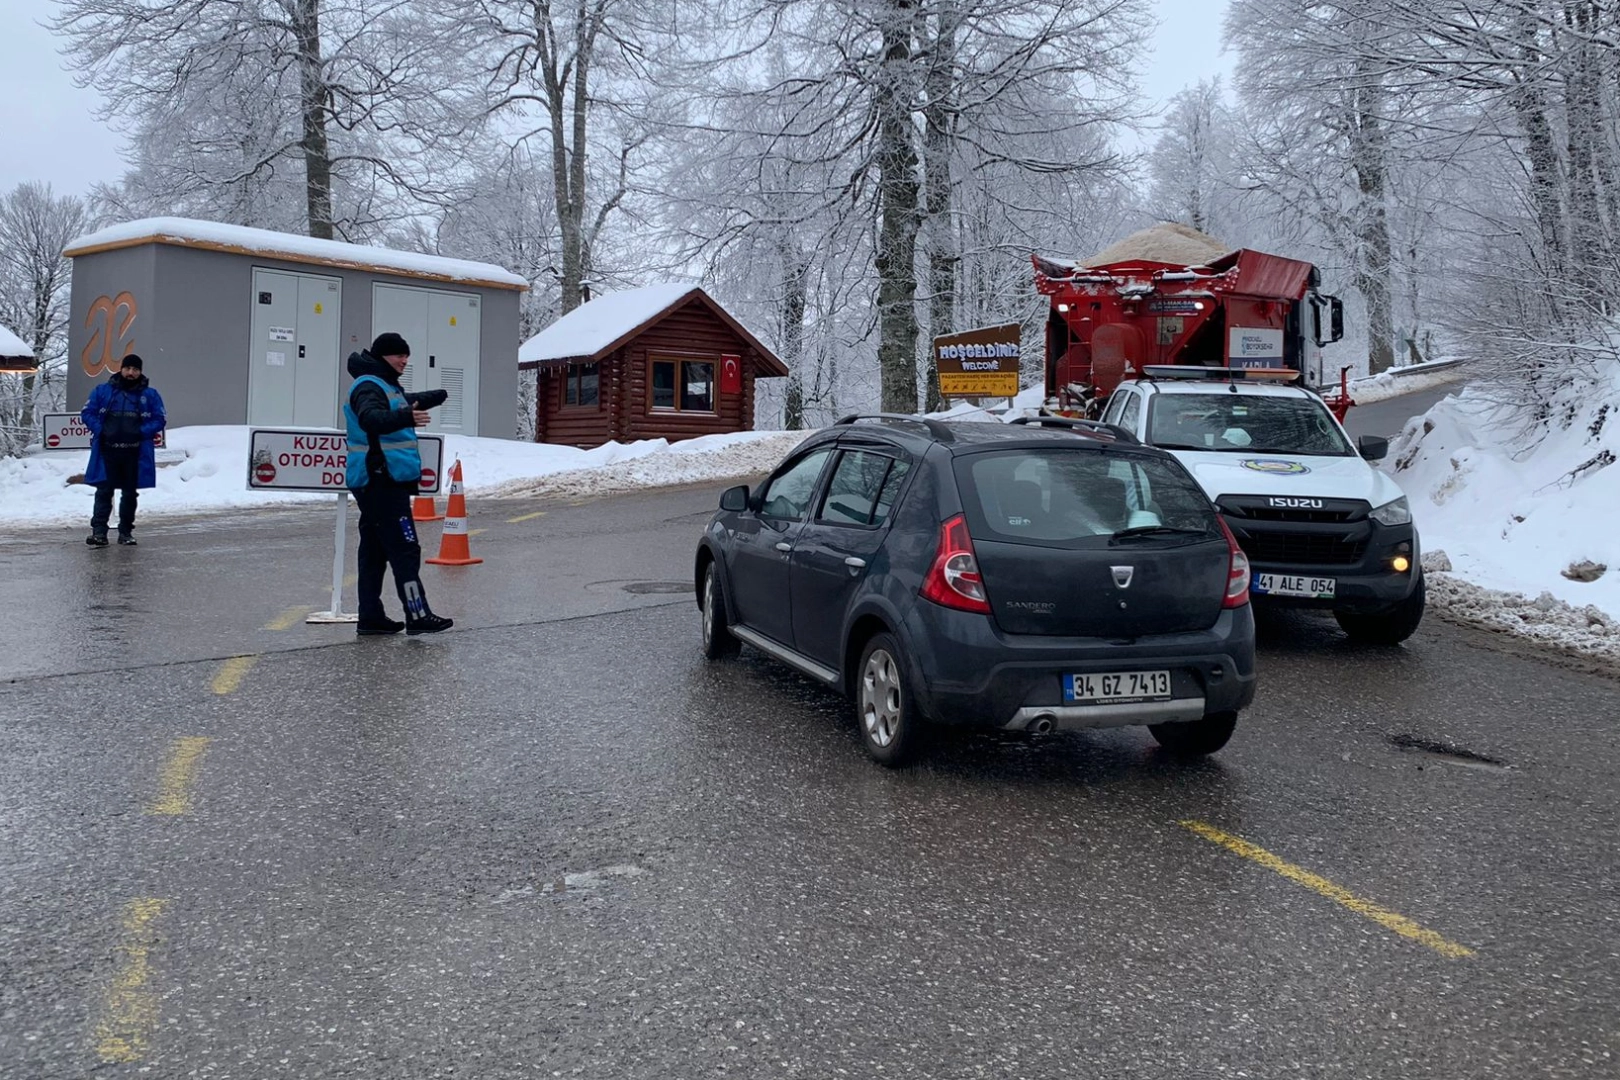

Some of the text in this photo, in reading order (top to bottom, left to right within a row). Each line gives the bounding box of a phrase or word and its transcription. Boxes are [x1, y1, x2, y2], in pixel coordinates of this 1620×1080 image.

[938, 342, 1019, 361] HOŞGELDİNİZ
[962, 360, 999, 370] WELCOME
[61, 427, 92, 436] OTOP
[322, 471, 345, 486] DO
[1269, 497, 1322, 508] ISUZU
[1259, 575, 1273, 588] 41
[1280, 576, 1304, 591] ALE
[1311, 579, 1334, 593] 054
[1006, 601, 1056, 610] SANDERO
[1075, 676, 1094, 696] 34
[1102, 675, 1122, 695] GZ
[1129, 673, 1168, 694] 7413
